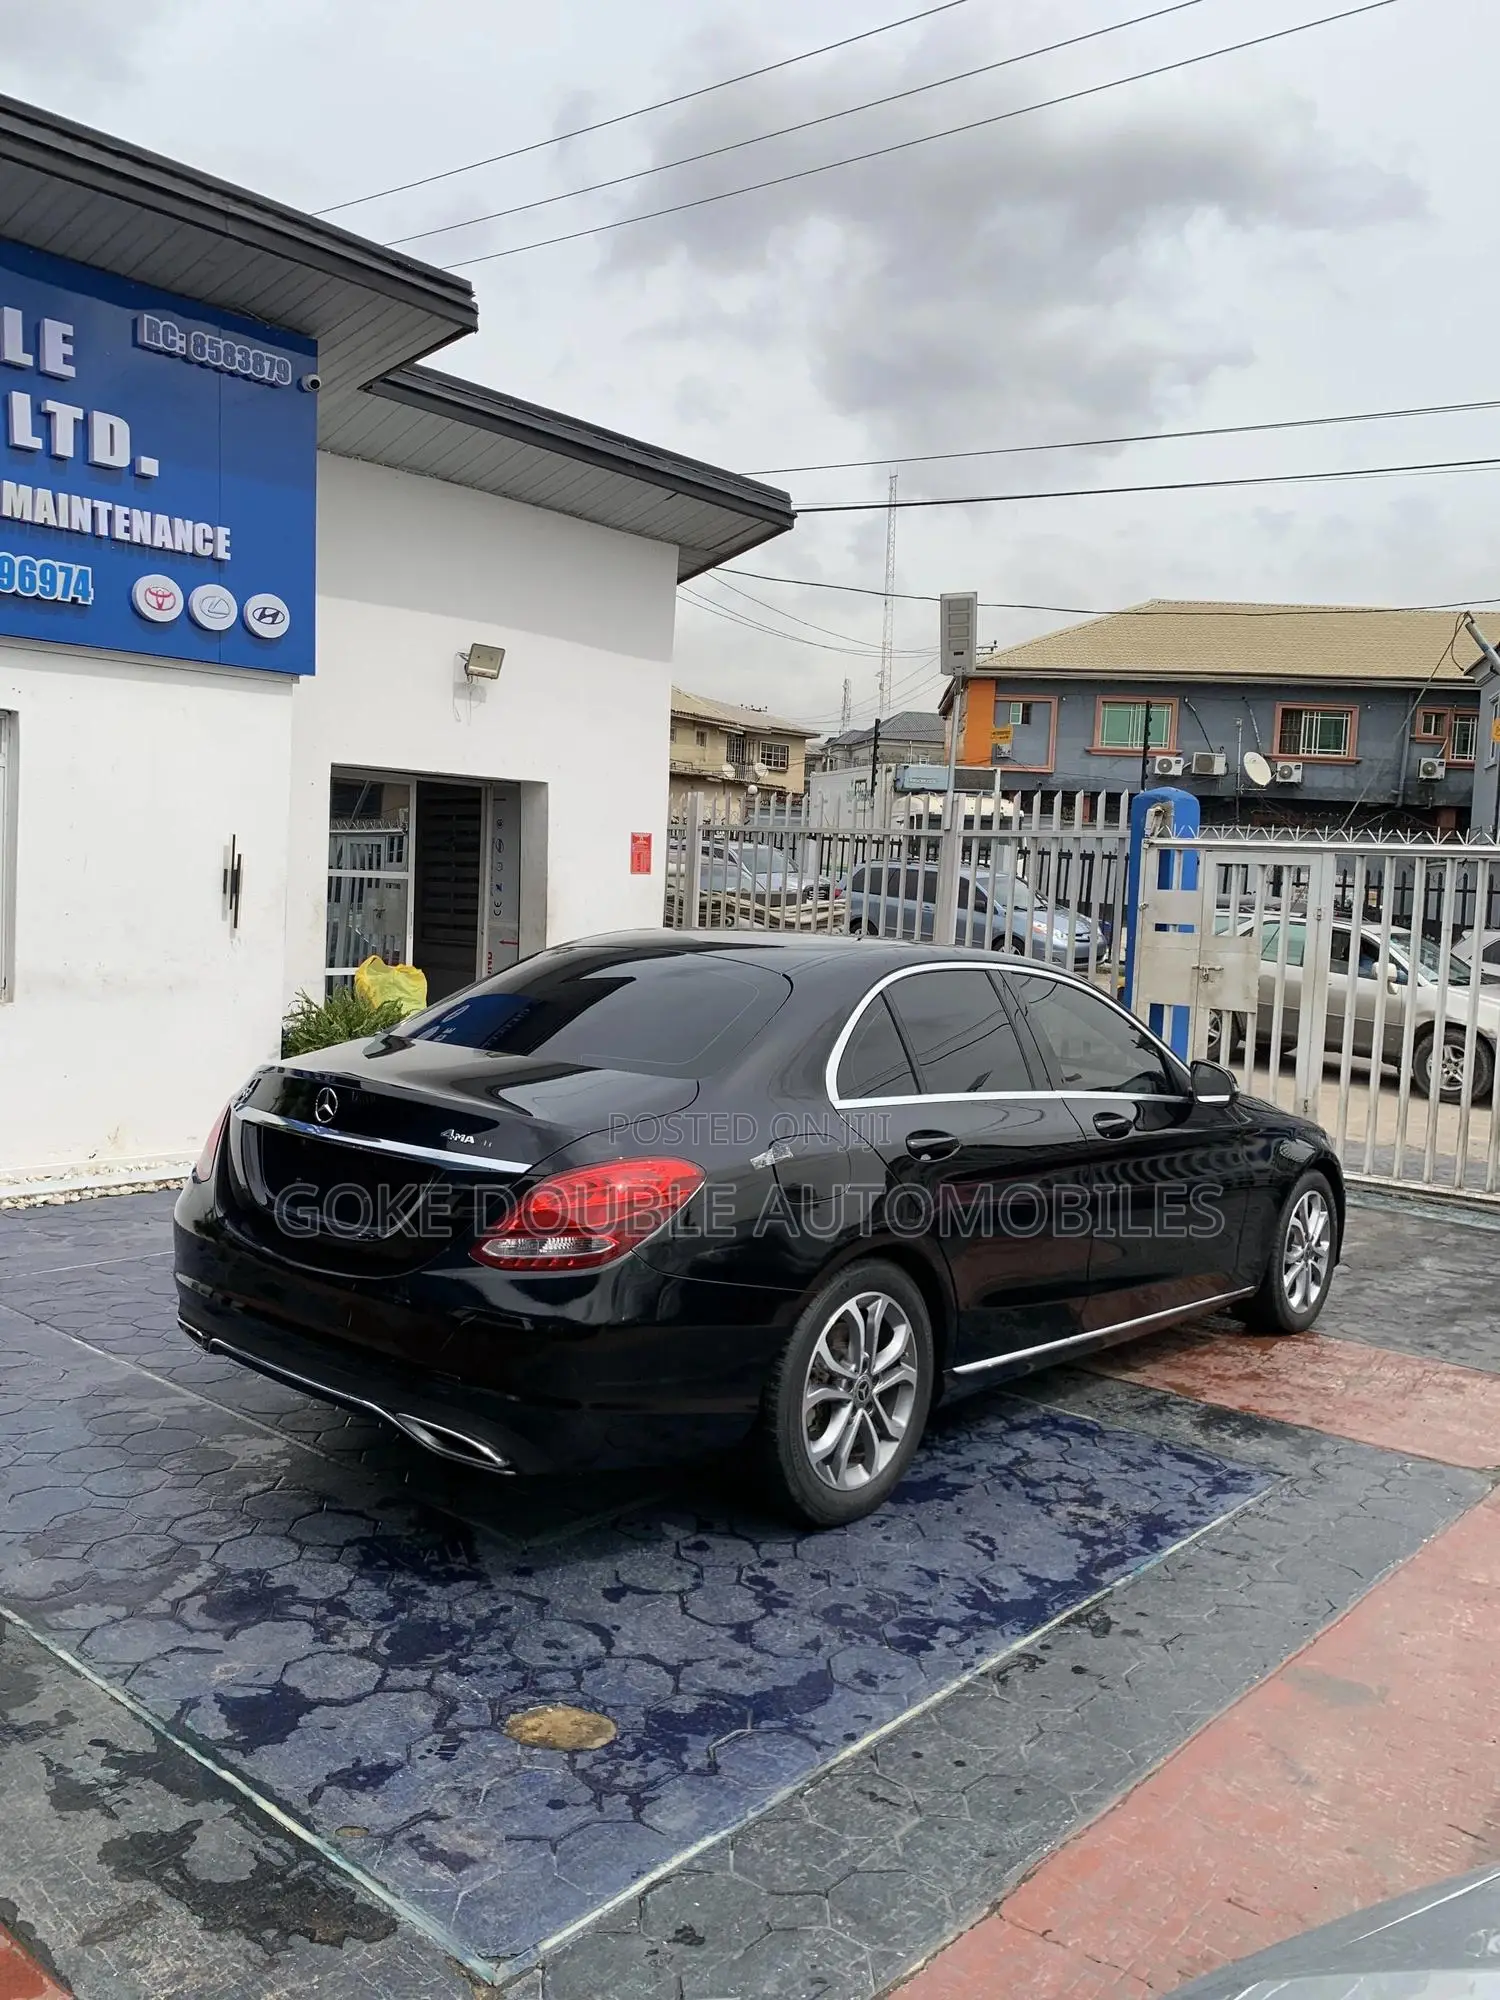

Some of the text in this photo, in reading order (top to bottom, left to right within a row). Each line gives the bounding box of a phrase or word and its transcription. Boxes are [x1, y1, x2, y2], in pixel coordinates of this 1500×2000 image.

[138, 313, 292, 386] RC: 8583879
[8, 390, 159, 477] LTD.
[0, 480, 231, 561] MAINTENANCE
